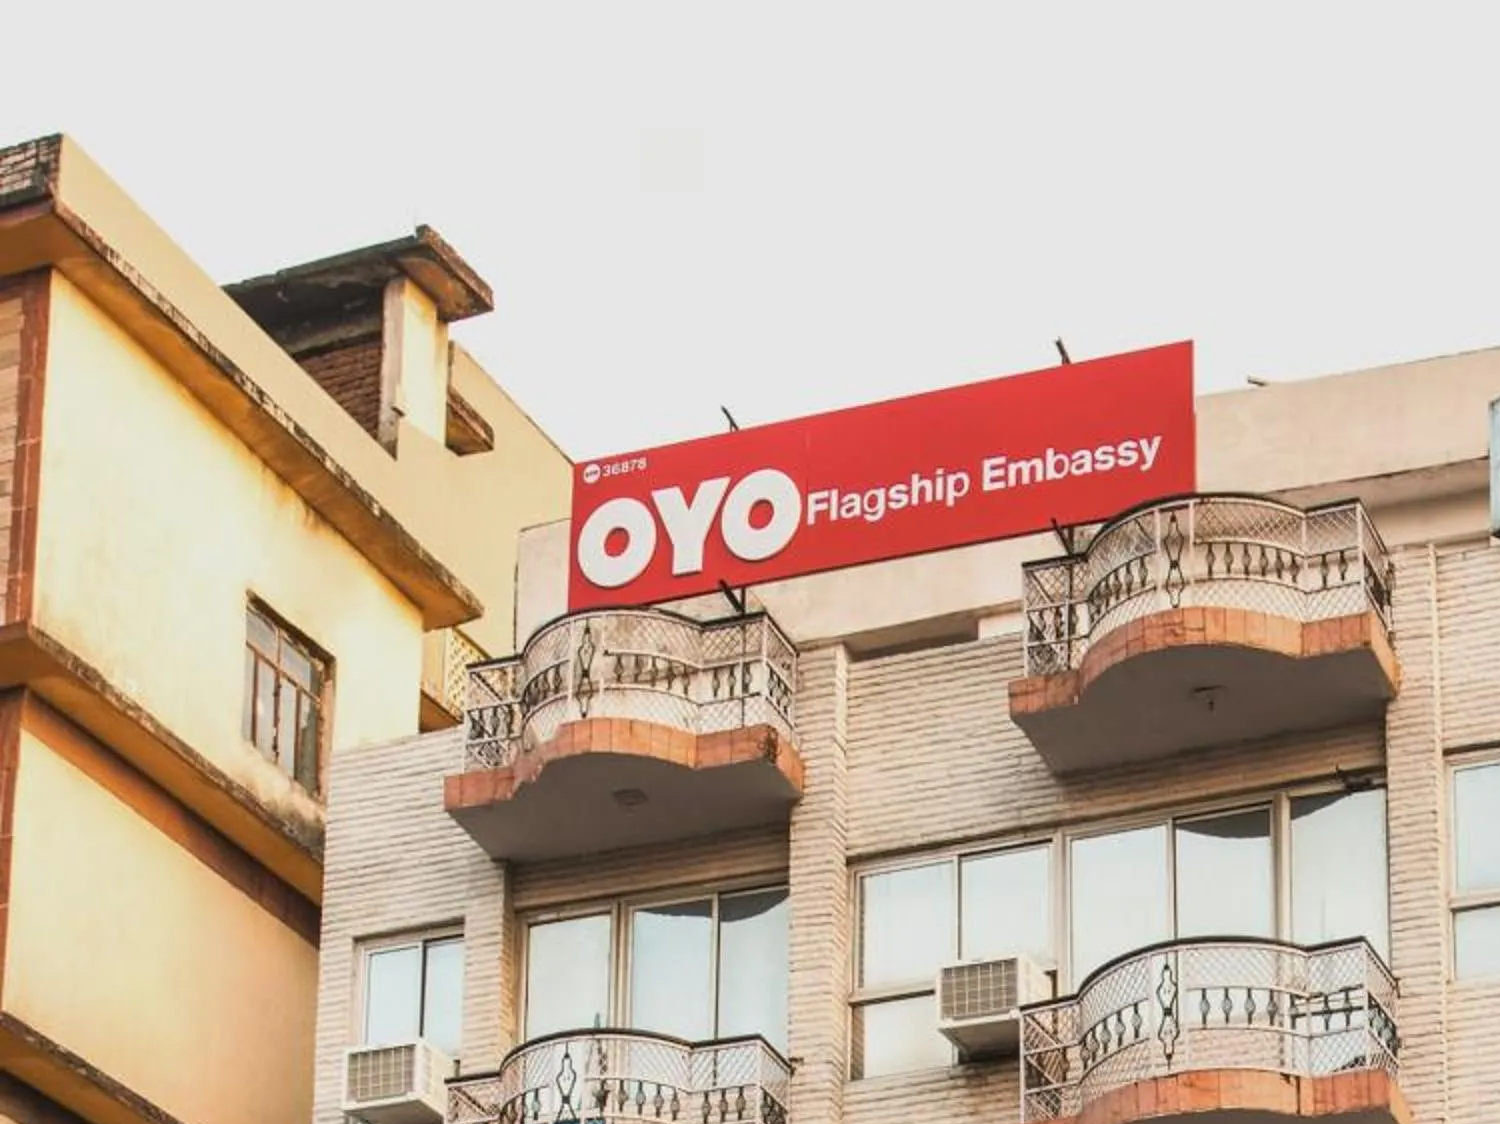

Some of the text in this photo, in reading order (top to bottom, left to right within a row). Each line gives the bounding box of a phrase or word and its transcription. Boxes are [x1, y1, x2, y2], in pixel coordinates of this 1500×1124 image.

[577, 435, 1161, 588] OYO Flagship Embassy
